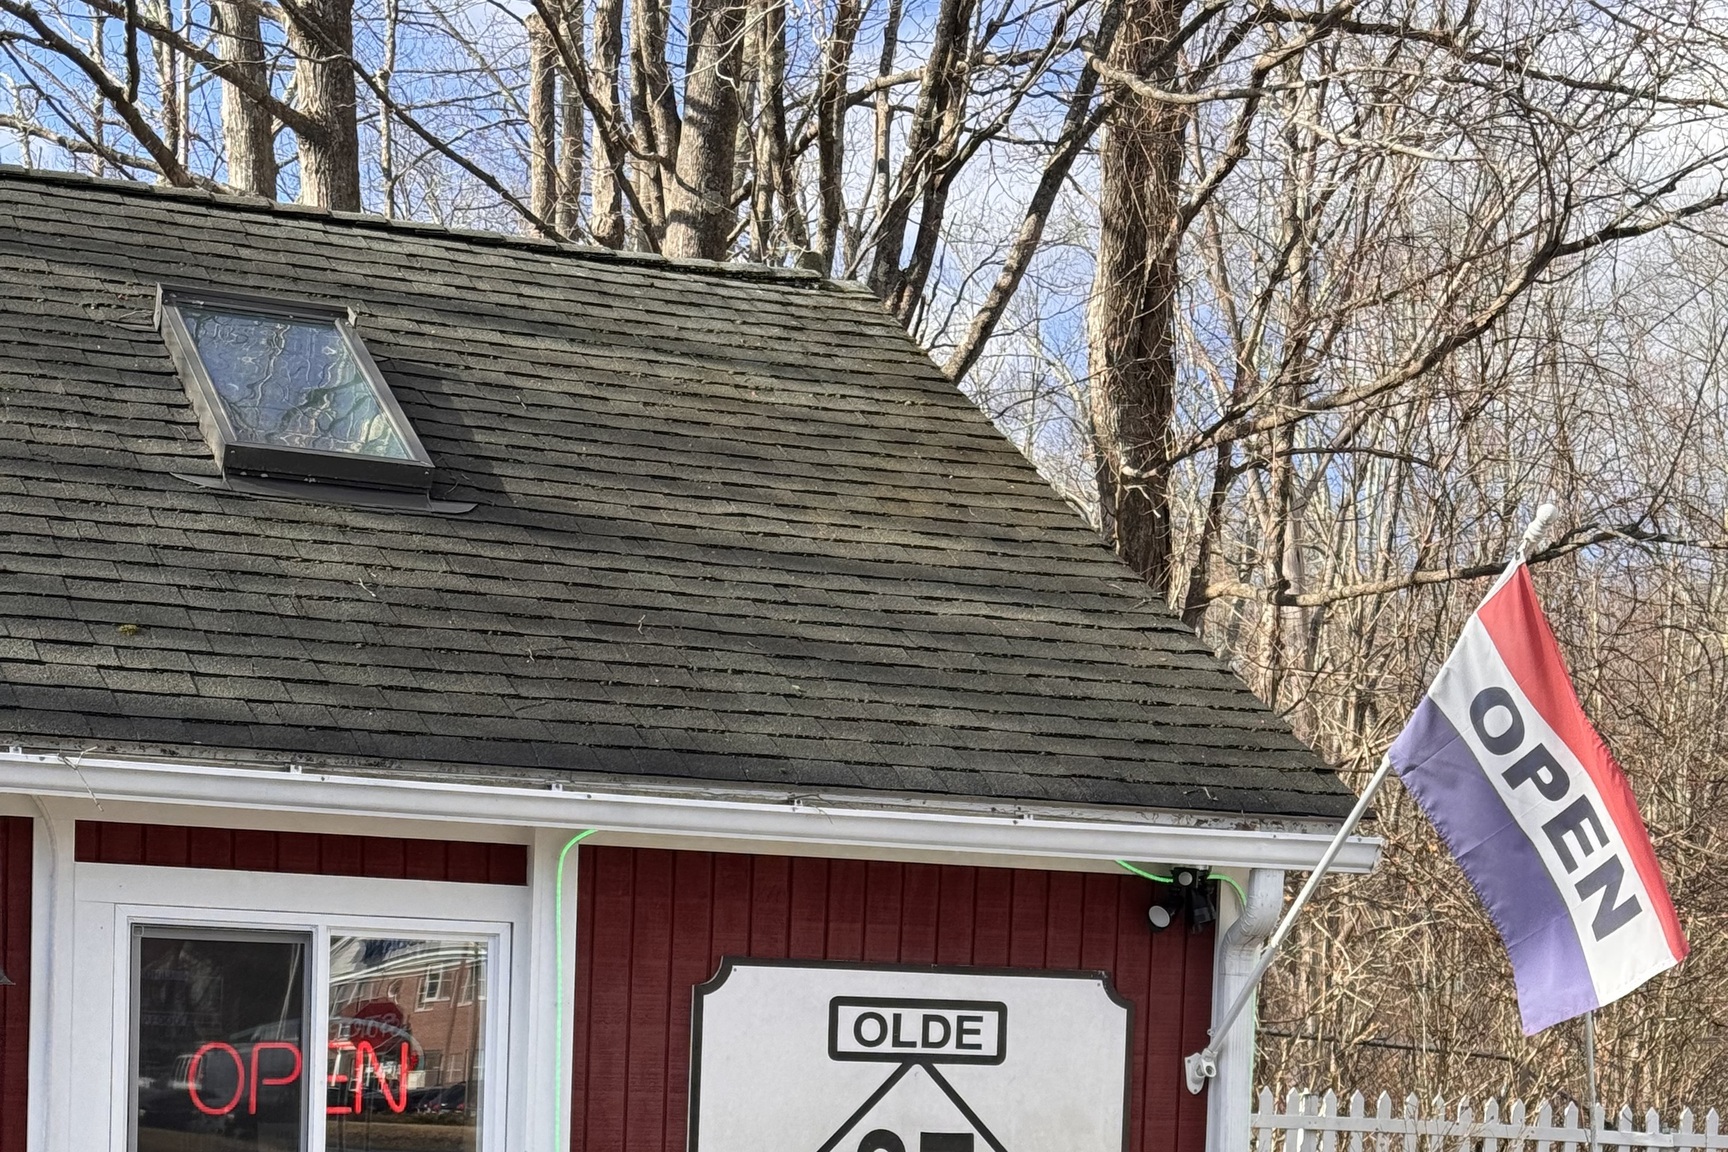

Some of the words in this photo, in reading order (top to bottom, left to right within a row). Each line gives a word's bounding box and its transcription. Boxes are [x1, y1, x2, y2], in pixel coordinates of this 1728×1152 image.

[1469, 686, 1643, 942] OPEN
[853, 1011, 984, 1051] OLDE
[188, 1041, 410, 1116] OPEN
